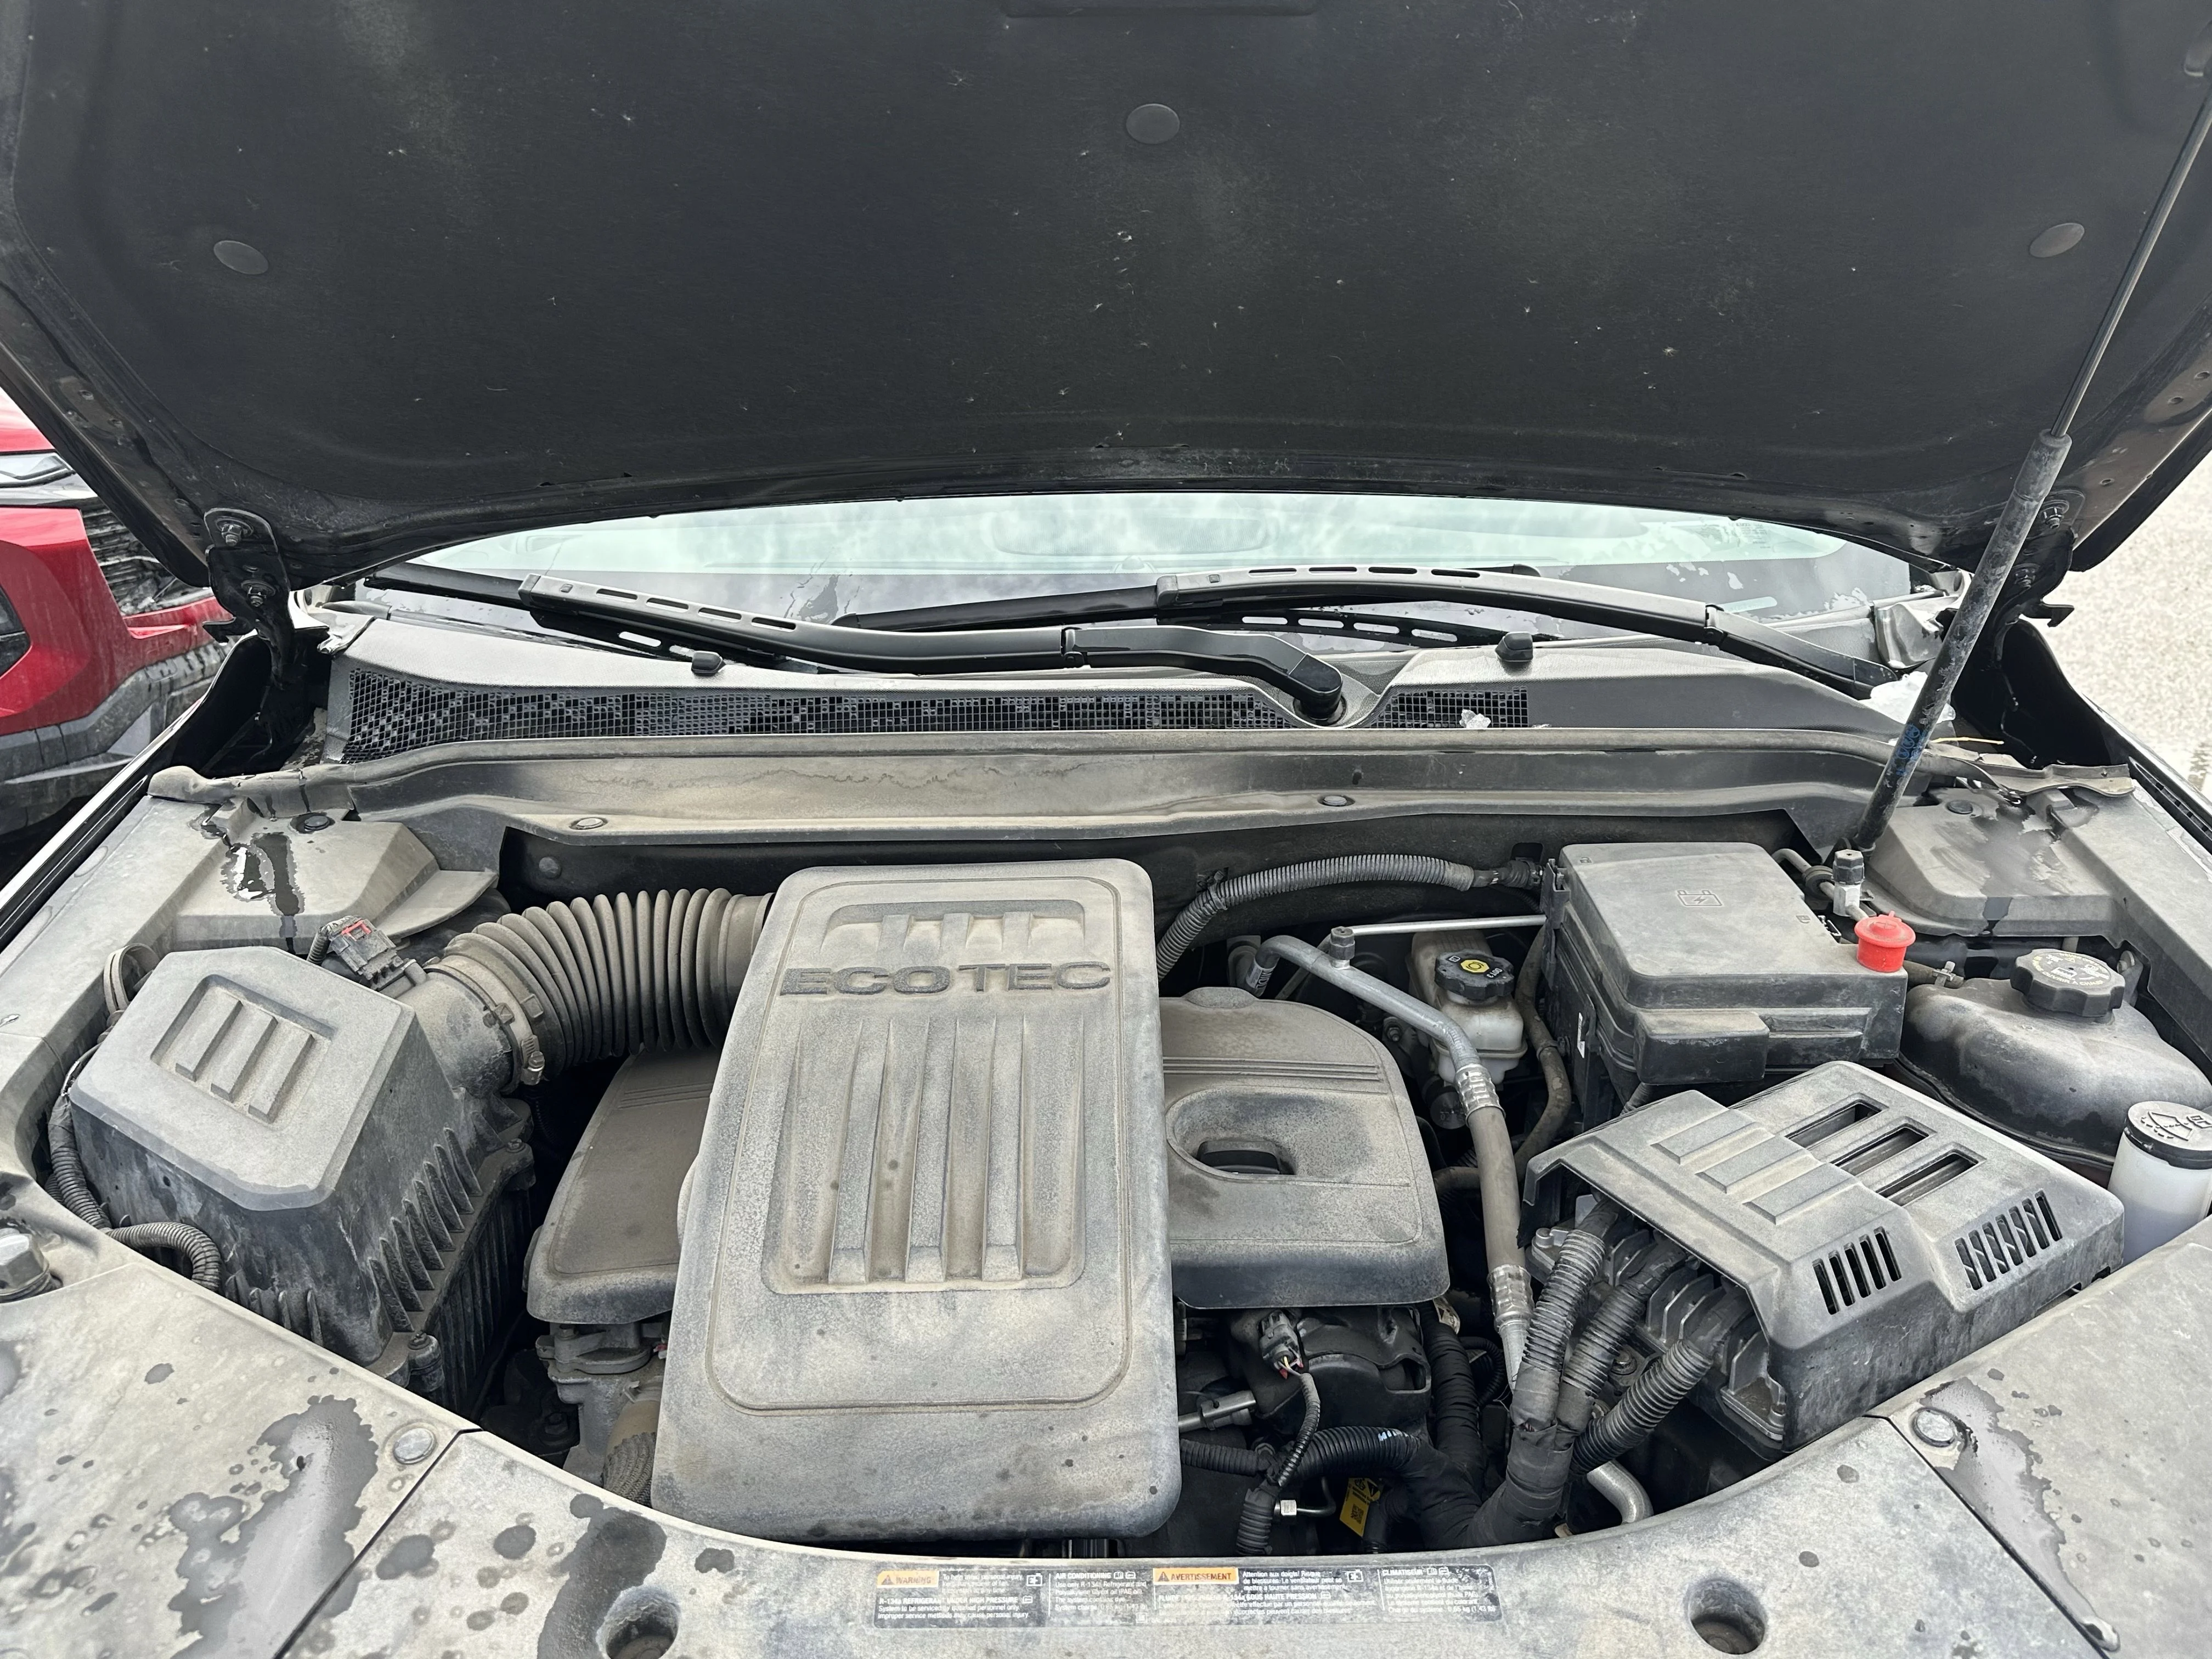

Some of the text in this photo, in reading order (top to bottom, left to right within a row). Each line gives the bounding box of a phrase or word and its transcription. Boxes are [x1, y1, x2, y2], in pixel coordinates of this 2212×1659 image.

[780, 961, 1110, 996] ECOTEC
[896, 1576, 931, 1584] WARNING
[1103, 1581, 1135, 1589] Refrigerant
[1055, 1604, 1076, 1612] System
